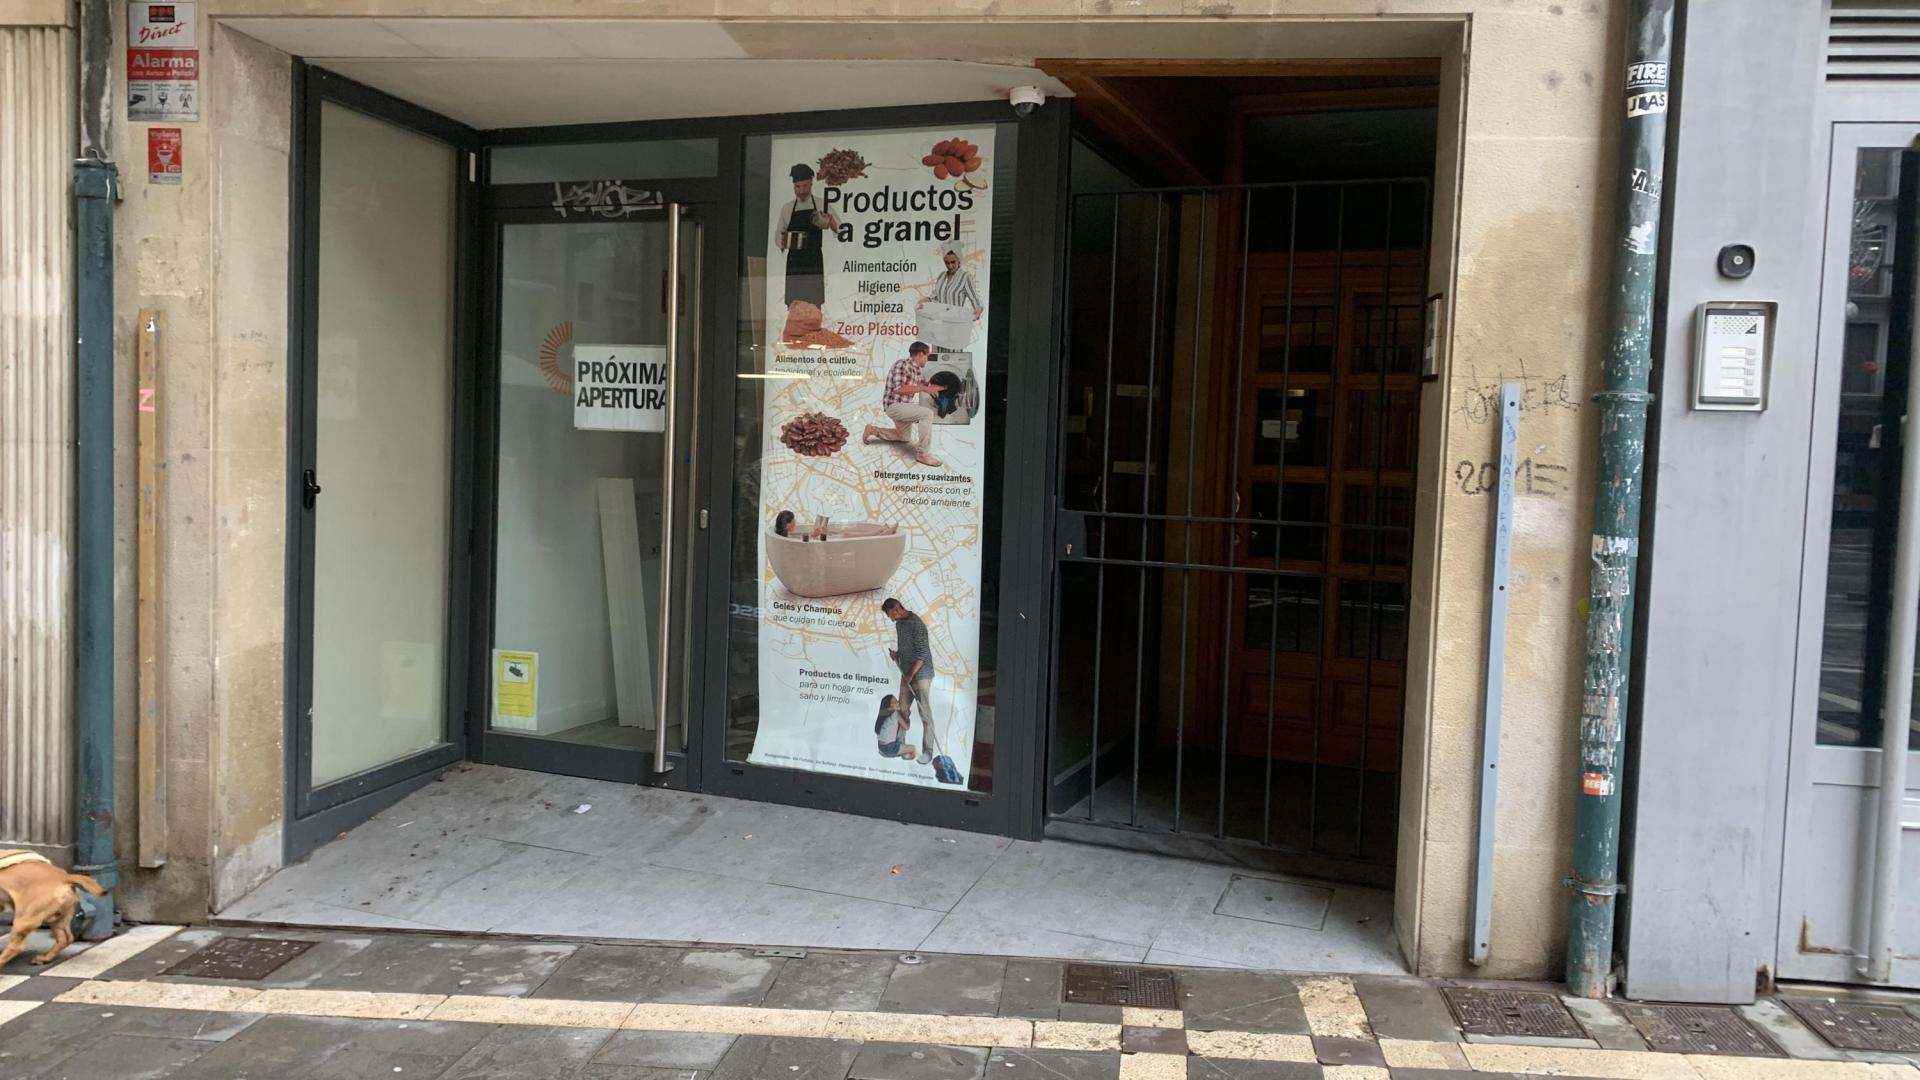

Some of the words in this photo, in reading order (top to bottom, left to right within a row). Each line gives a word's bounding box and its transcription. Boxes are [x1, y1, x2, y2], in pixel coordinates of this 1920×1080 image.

[138, 22, 186, 43] Direct
[133, 54, 194, 67] Alarma
[1628, 64, 1665, 81] FIRE
[824, 185, 973, 214] Productos
[837, 223, 853, 242] a
[863, 214, 960, 248] granel
[843, 260, 916, 272] Alimentación
[858, 281, 900, 295] Higiene
[854, 301, 903, 315] Limpieza
[837, 322, 864, 335] Zero
[868, 321, 919, 336] Plástico
[776, 355, 814, 363] Alimentos
[817, 356, 826, 364] de
[829, 356, 856, 364] cultivo
[875, 471, 919, 480] Detergentes
[927, 474, 970, 483] suavizantes
[892, 485, 942, 493] respetuosos
[946, 487, 960, 495] con
[903, 497, 928, 505] medio
[931, 499, 970, 507] ambiente
[774, 602, 795, 610] Geles
[773, 614, 787, 623] que
[790, 616, 815, 624] cuidan
[818, 617, 825, 625] tú
[828, 619, 855, 628] cuerpo
[800, 669, 840, 679] Productos
[856, 674, 889, 684] limpieza
[832, 684, 854, 693] hogar
[827, 695, 850, 704] limpio
